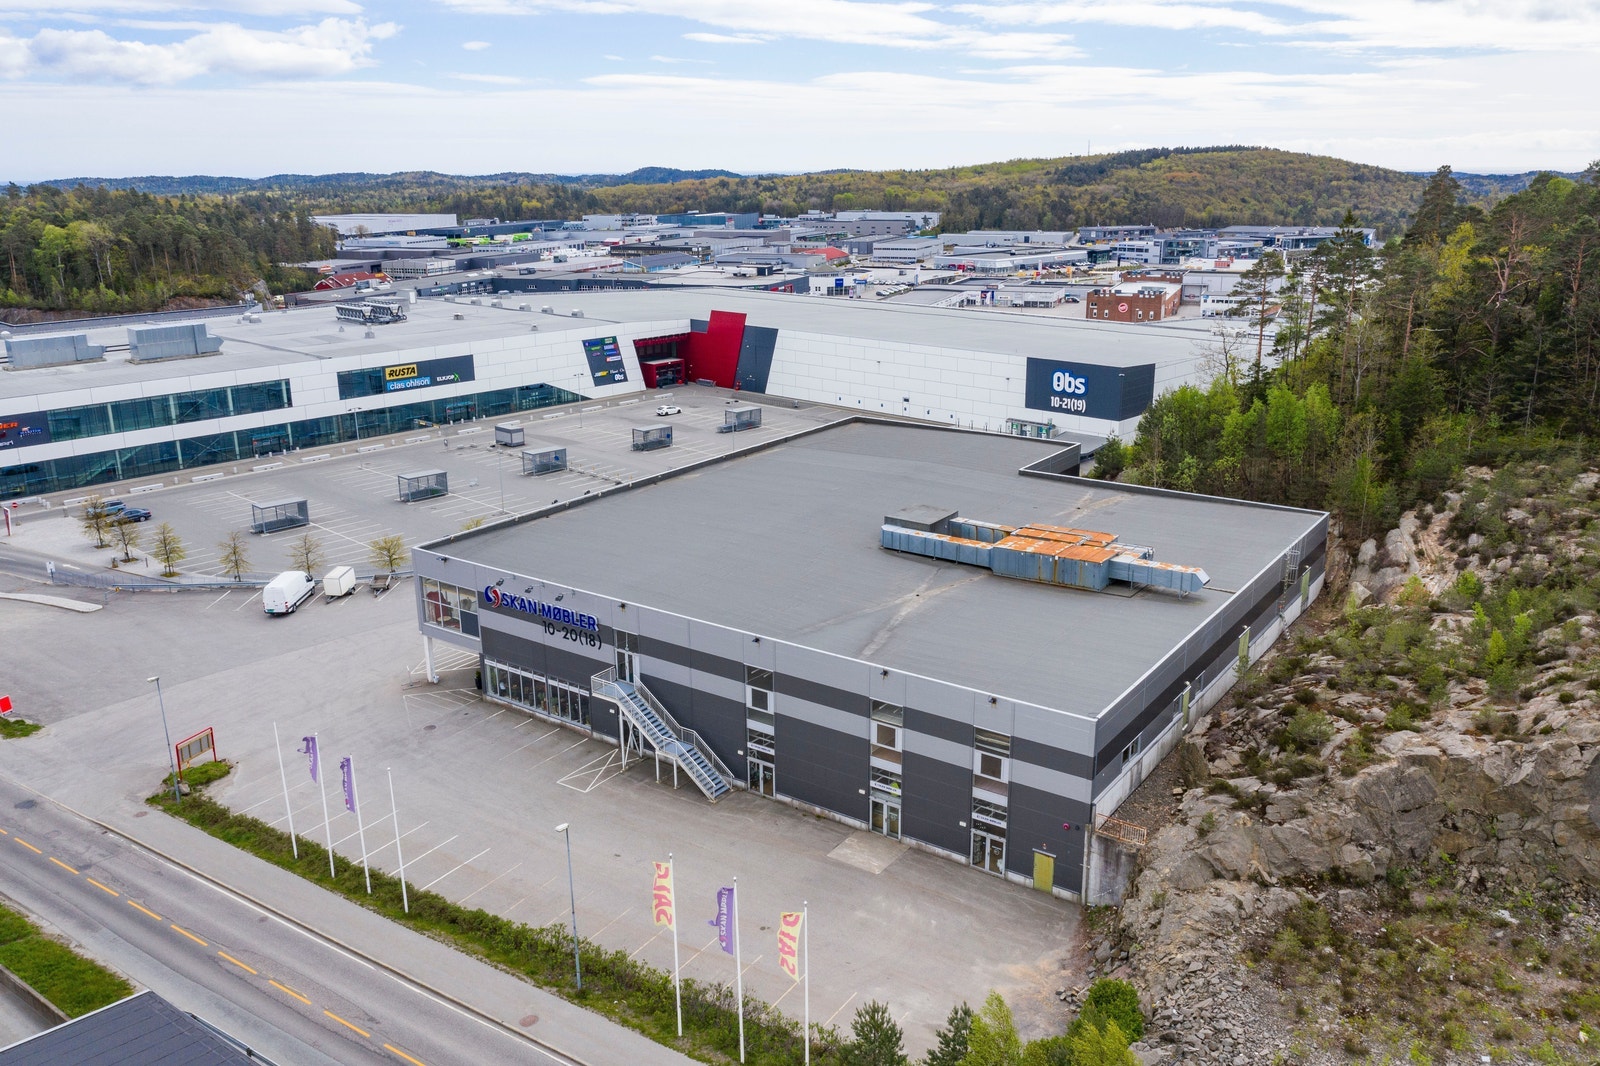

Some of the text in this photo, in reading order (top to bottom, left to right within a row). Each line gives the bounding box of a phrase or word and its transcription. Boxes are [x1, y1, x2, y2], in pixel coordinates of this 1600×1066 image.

[388, 366, 416, 378] RUSTA
[389, 377, 430, 390] clas ohlson
[1052, 371, 1086, 394] Obs
[1050, 396, 1087, 413] 10-21(19)
[501, 592, 599, 632] SKAN MØBLER
[542, 621, 602, 650] 10-20(18)
[720, 914, 728, 937] SKAN
